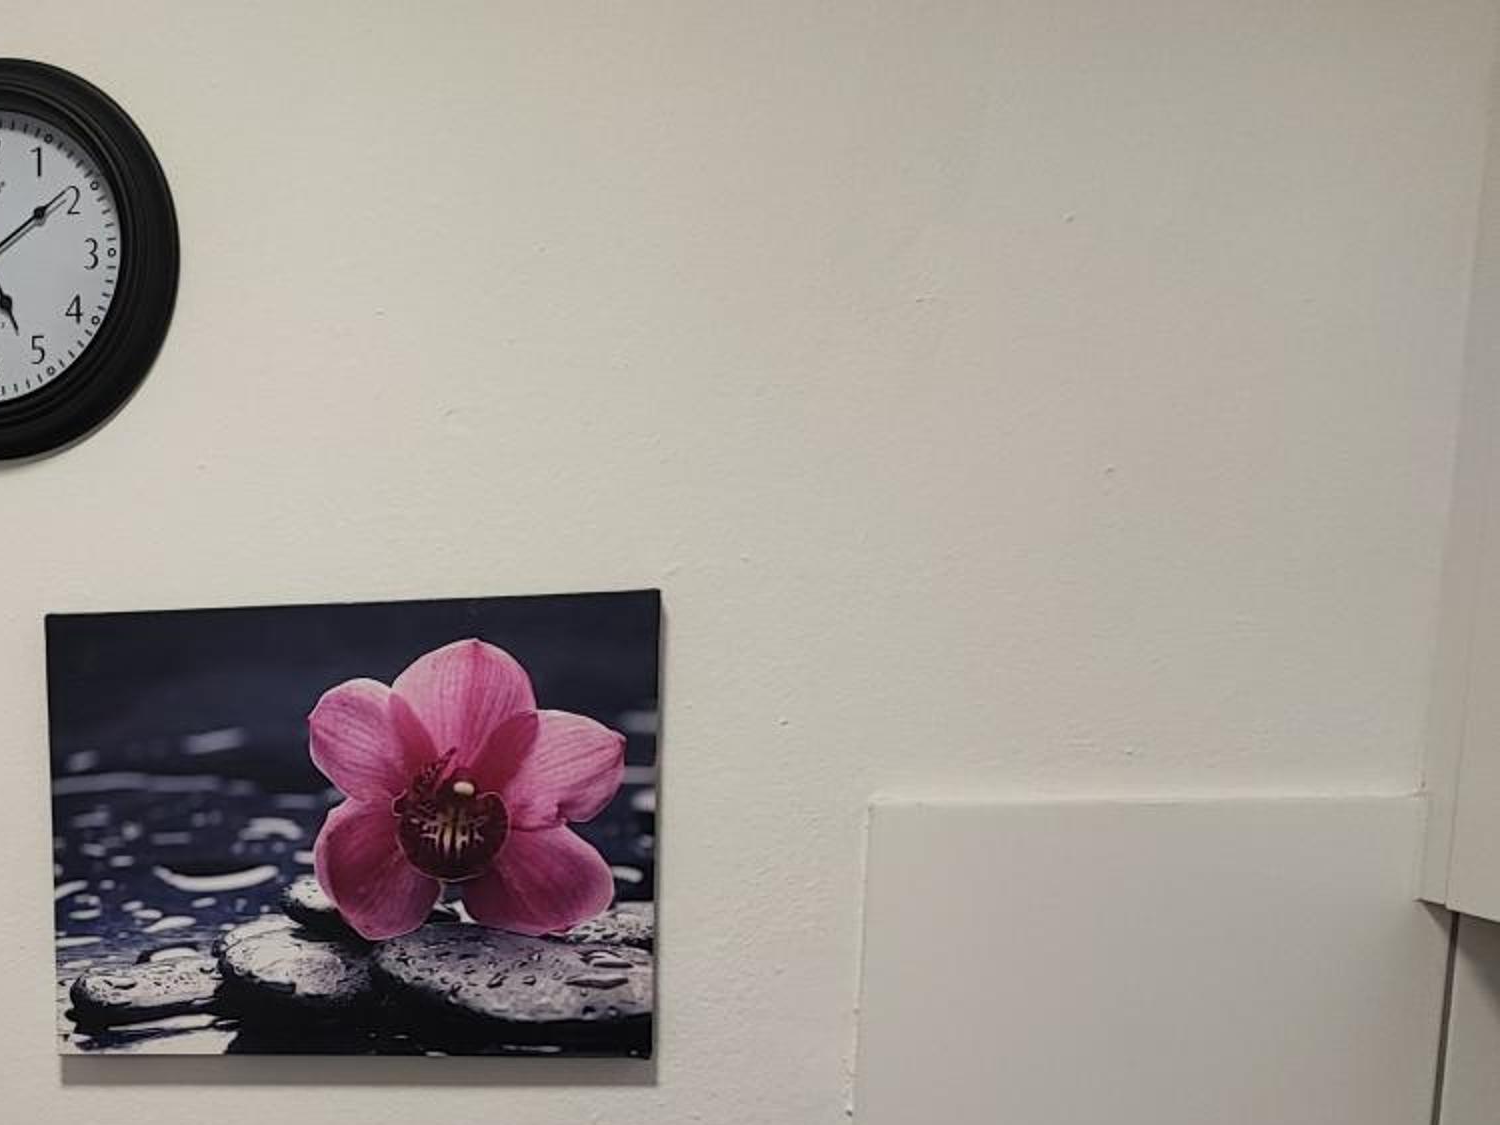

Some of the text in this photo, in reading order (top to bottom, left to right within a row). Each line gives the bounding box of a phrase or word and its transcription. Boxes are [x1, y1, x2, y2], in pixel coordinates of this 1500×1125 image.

[30, 146, 43, 177] 1
[67, 185, 81, 215] 2
[84, 239, 100, 270] 3
[65, 294, 84, 323] 4
[30, 336, 46, 365] 5
